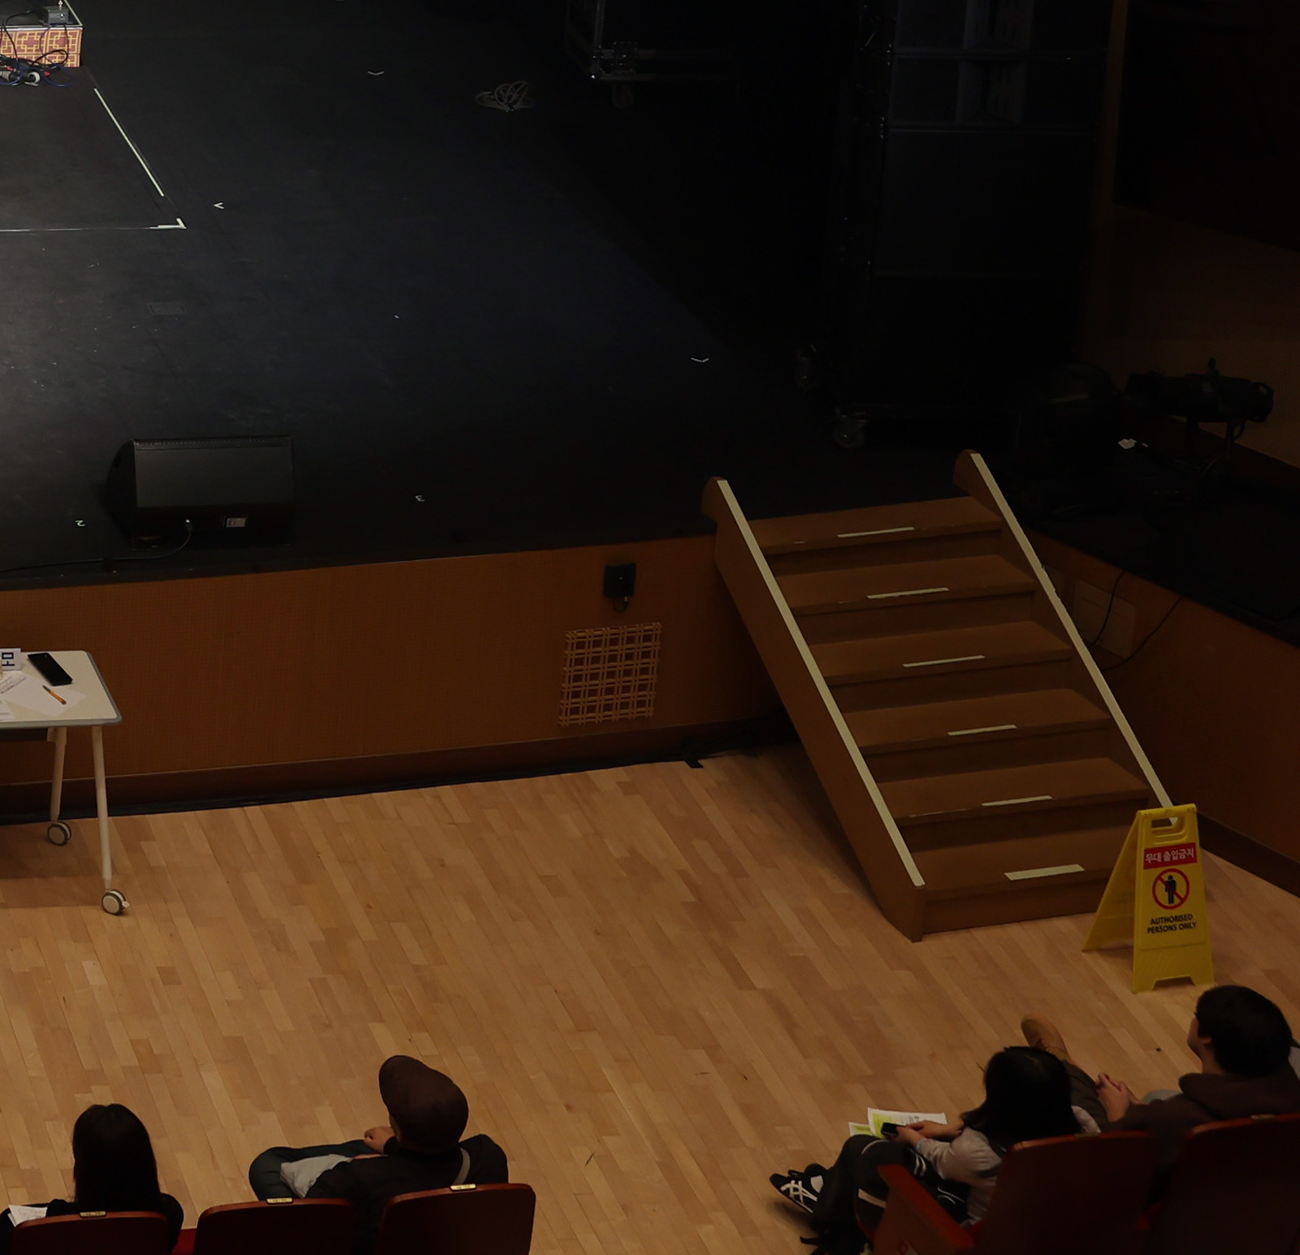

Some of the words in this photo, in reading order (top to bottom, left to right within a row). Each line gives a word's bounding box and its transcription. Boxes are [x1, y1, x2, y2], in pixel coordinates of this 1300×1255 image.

[1151, 913, 1193, 924] AUTHORISED
[1147, 924, 1177, 934] PERSONS
[1179, 922, 1196, 930] ONLY
